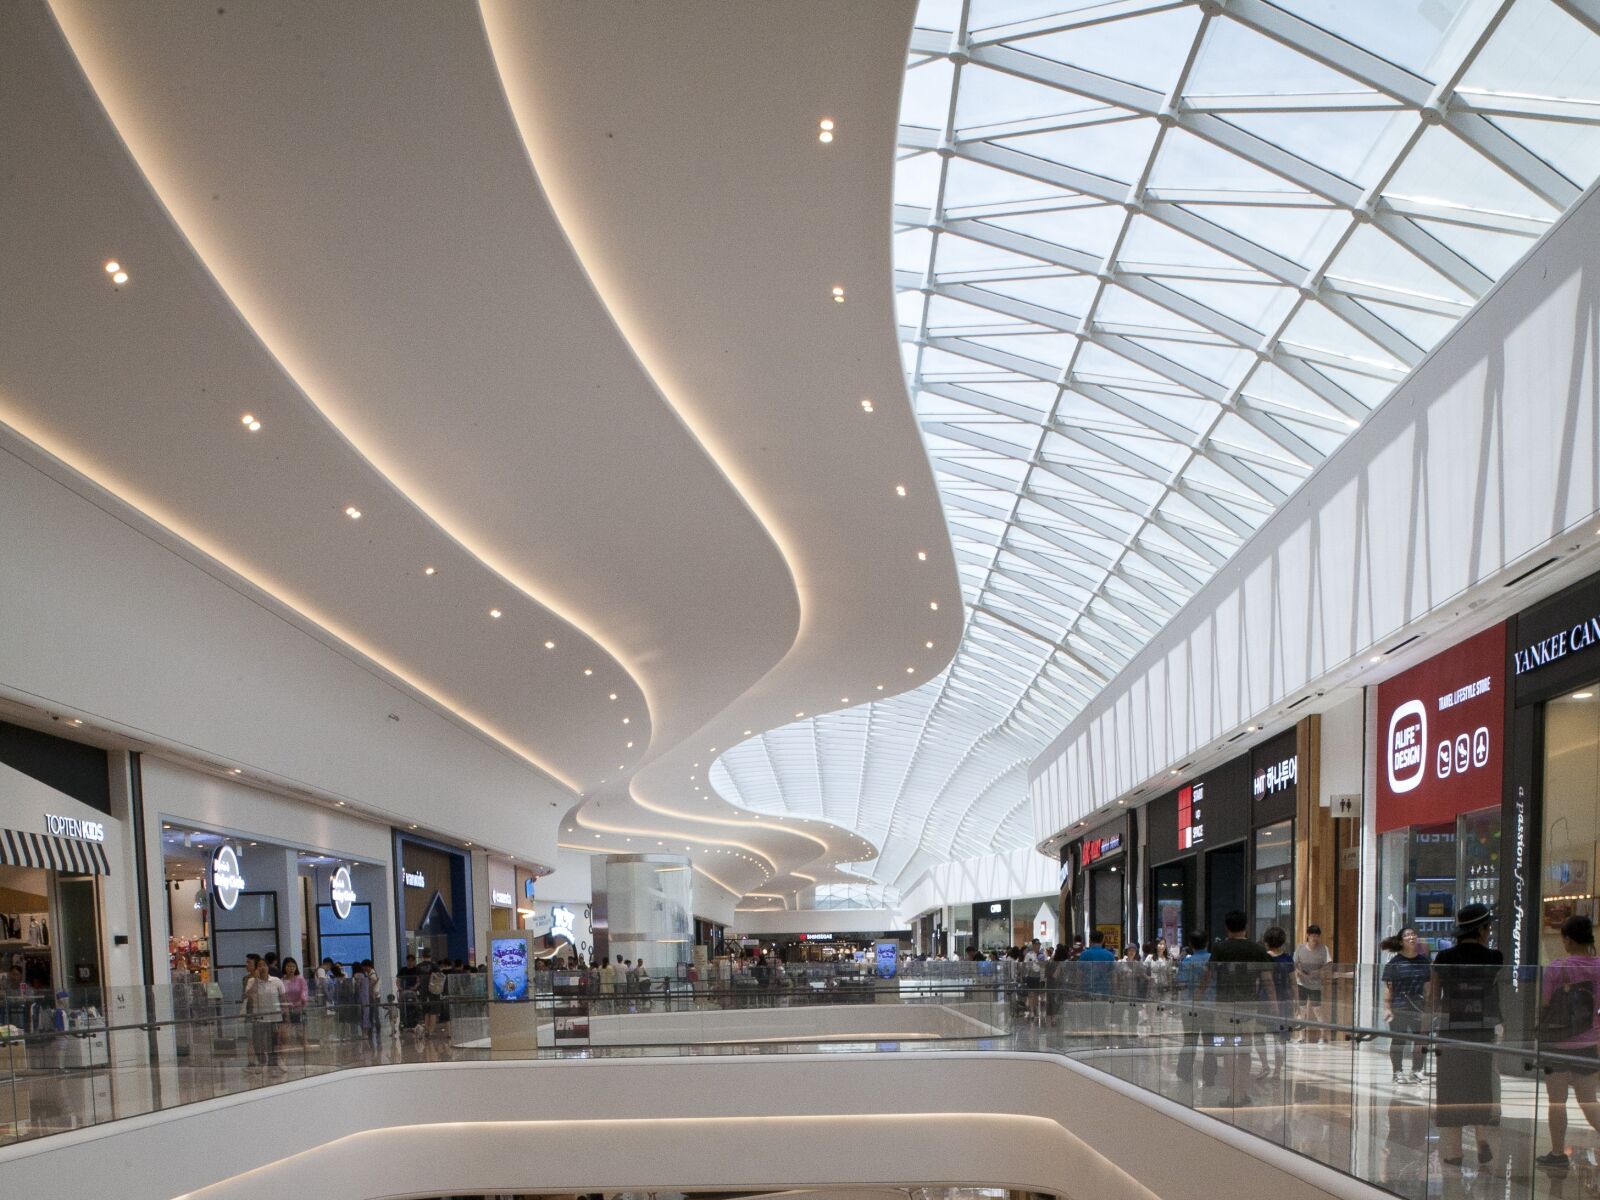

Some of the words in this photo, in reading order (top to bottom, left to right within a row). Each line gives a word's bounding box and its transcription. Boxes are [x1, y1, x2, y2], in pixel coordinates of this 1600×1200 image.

[1514, 631, 1567, 675] YANKEE
[1454, 683, 1477, 705] LIFESTYLE
[1476, 676, 1491, 696] STORE
[1266, 755, 1298, 794] 하나투어
[1394, 744, 1421, 771] DESIGN
[1515, 801, 1525, 867] passion
[1514, 868, 1525, 903] for
[1512, 905, 1525, 988] fragrance
